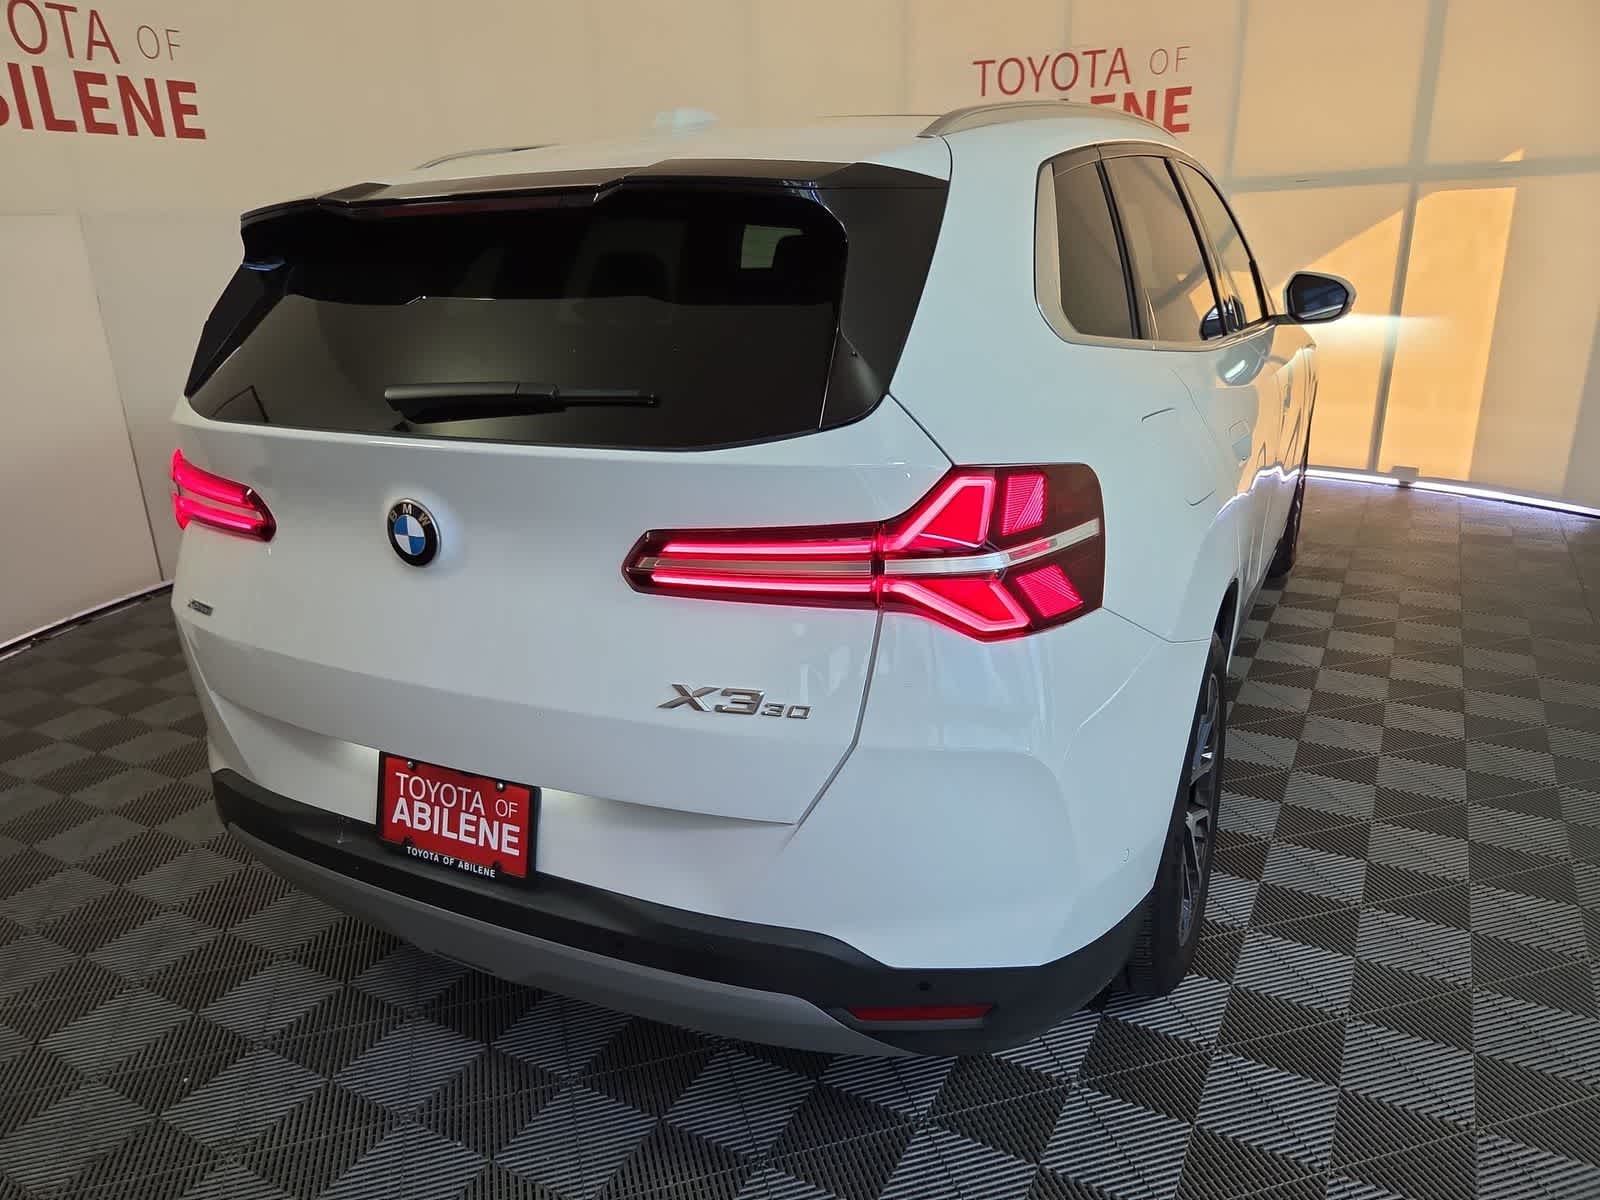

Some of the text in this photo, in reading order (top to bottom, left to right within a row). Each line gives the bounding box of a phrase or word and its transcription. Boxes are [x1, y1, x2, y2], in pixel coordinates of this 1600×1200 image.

[137, 25, 180, 61] OF
[973, 46, 1190, 97] TOYOTA OF
[389, 504, 431, 527] BMW
[395, 772, 518, 818] TOYOTA OF
[392, 797, 520, 856] ABILENE
[406, 846, 496, 878] TOYOTA OF ABILENE
